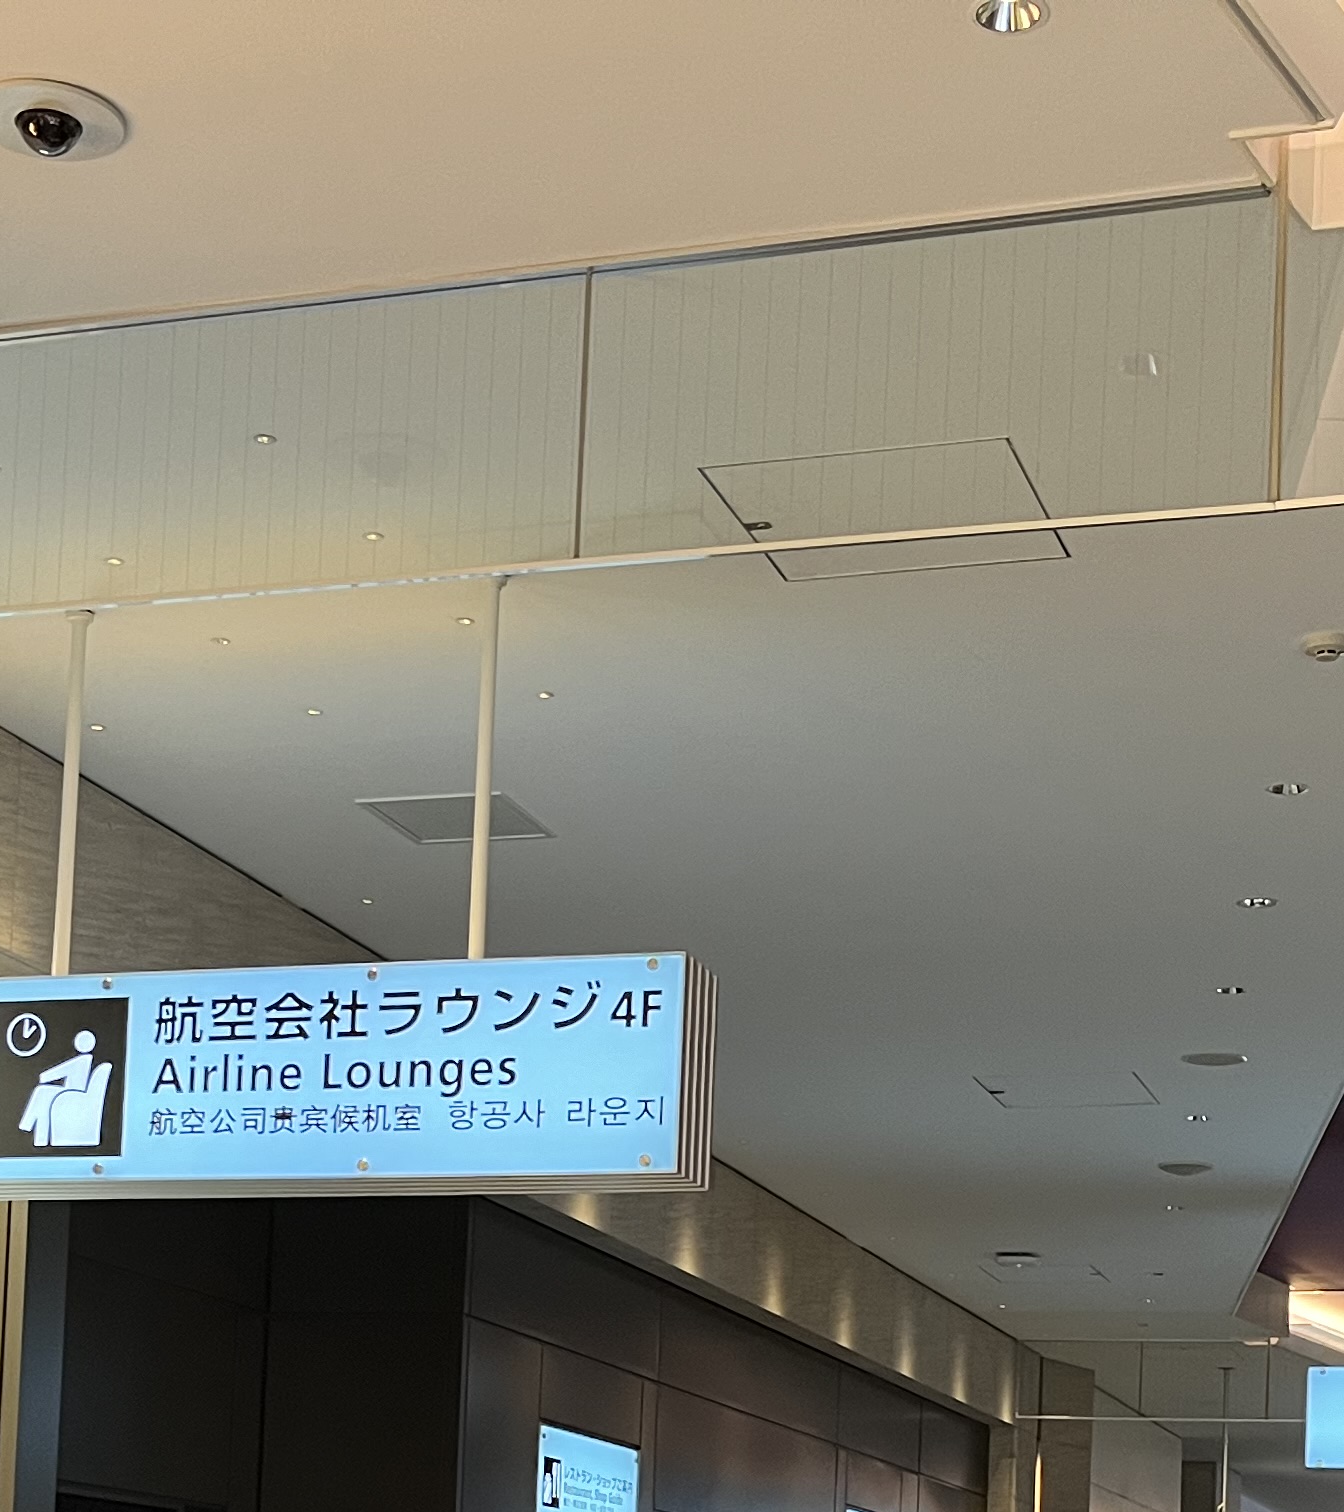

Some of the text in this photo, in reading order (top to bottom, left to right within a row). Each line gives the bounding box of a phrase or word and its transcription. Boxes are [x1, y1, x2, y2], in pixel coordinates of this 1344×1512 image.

[151, 1052, 518, 1098] Airline Lounges
[147, 1102, 422, 1137] 航空公司贵宾候机室
[448, 1095, 665, 1131] 항공사 라운지
